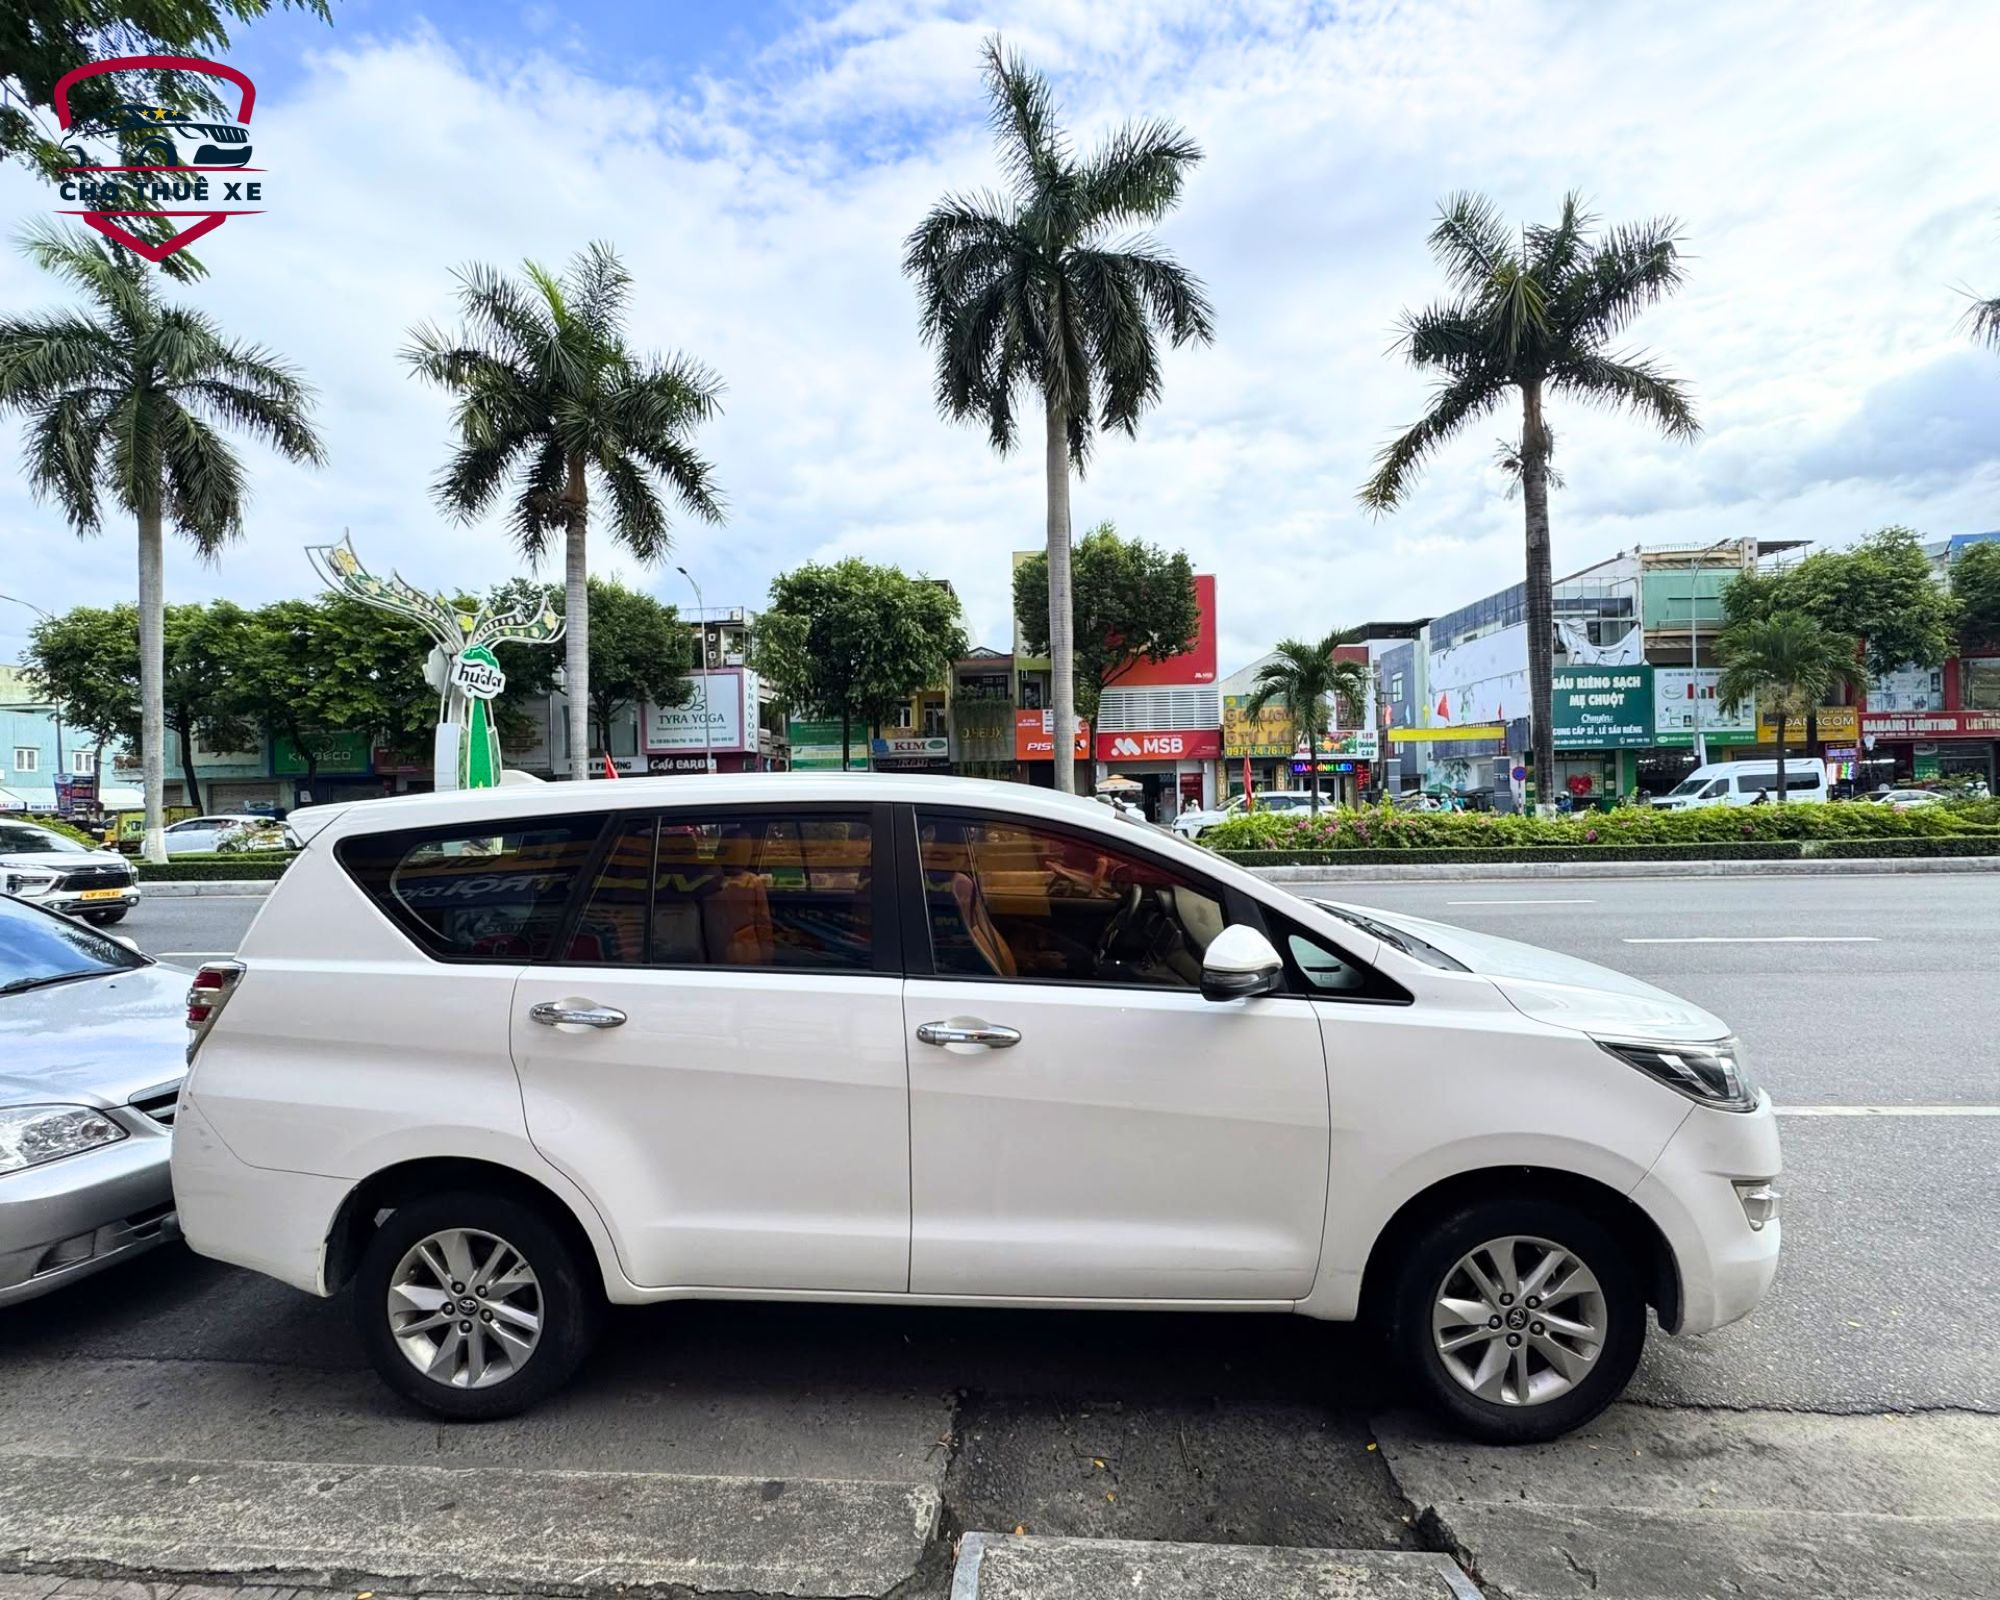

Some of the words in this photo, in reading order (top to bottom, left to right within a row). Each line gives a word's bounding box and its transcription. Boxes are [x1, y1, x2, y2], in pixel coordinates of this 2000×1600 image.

[458, 664, 502, 687] huda
[1613, 676, 1641, 691] SẠCH
[1569, 694, 1586, 709] MẸ
[1588, 691, 1625, 708] CHUỘT
[658, 713, 688, 724] TYRA
[692, 713, 725, 723] YOGA
[894, 741, 926, 750] KIM
[1027, 742, 1054, 751] PIS
[1143, 738, 1184, 754] MSB
[1336, 762, 1353, 771] LED
